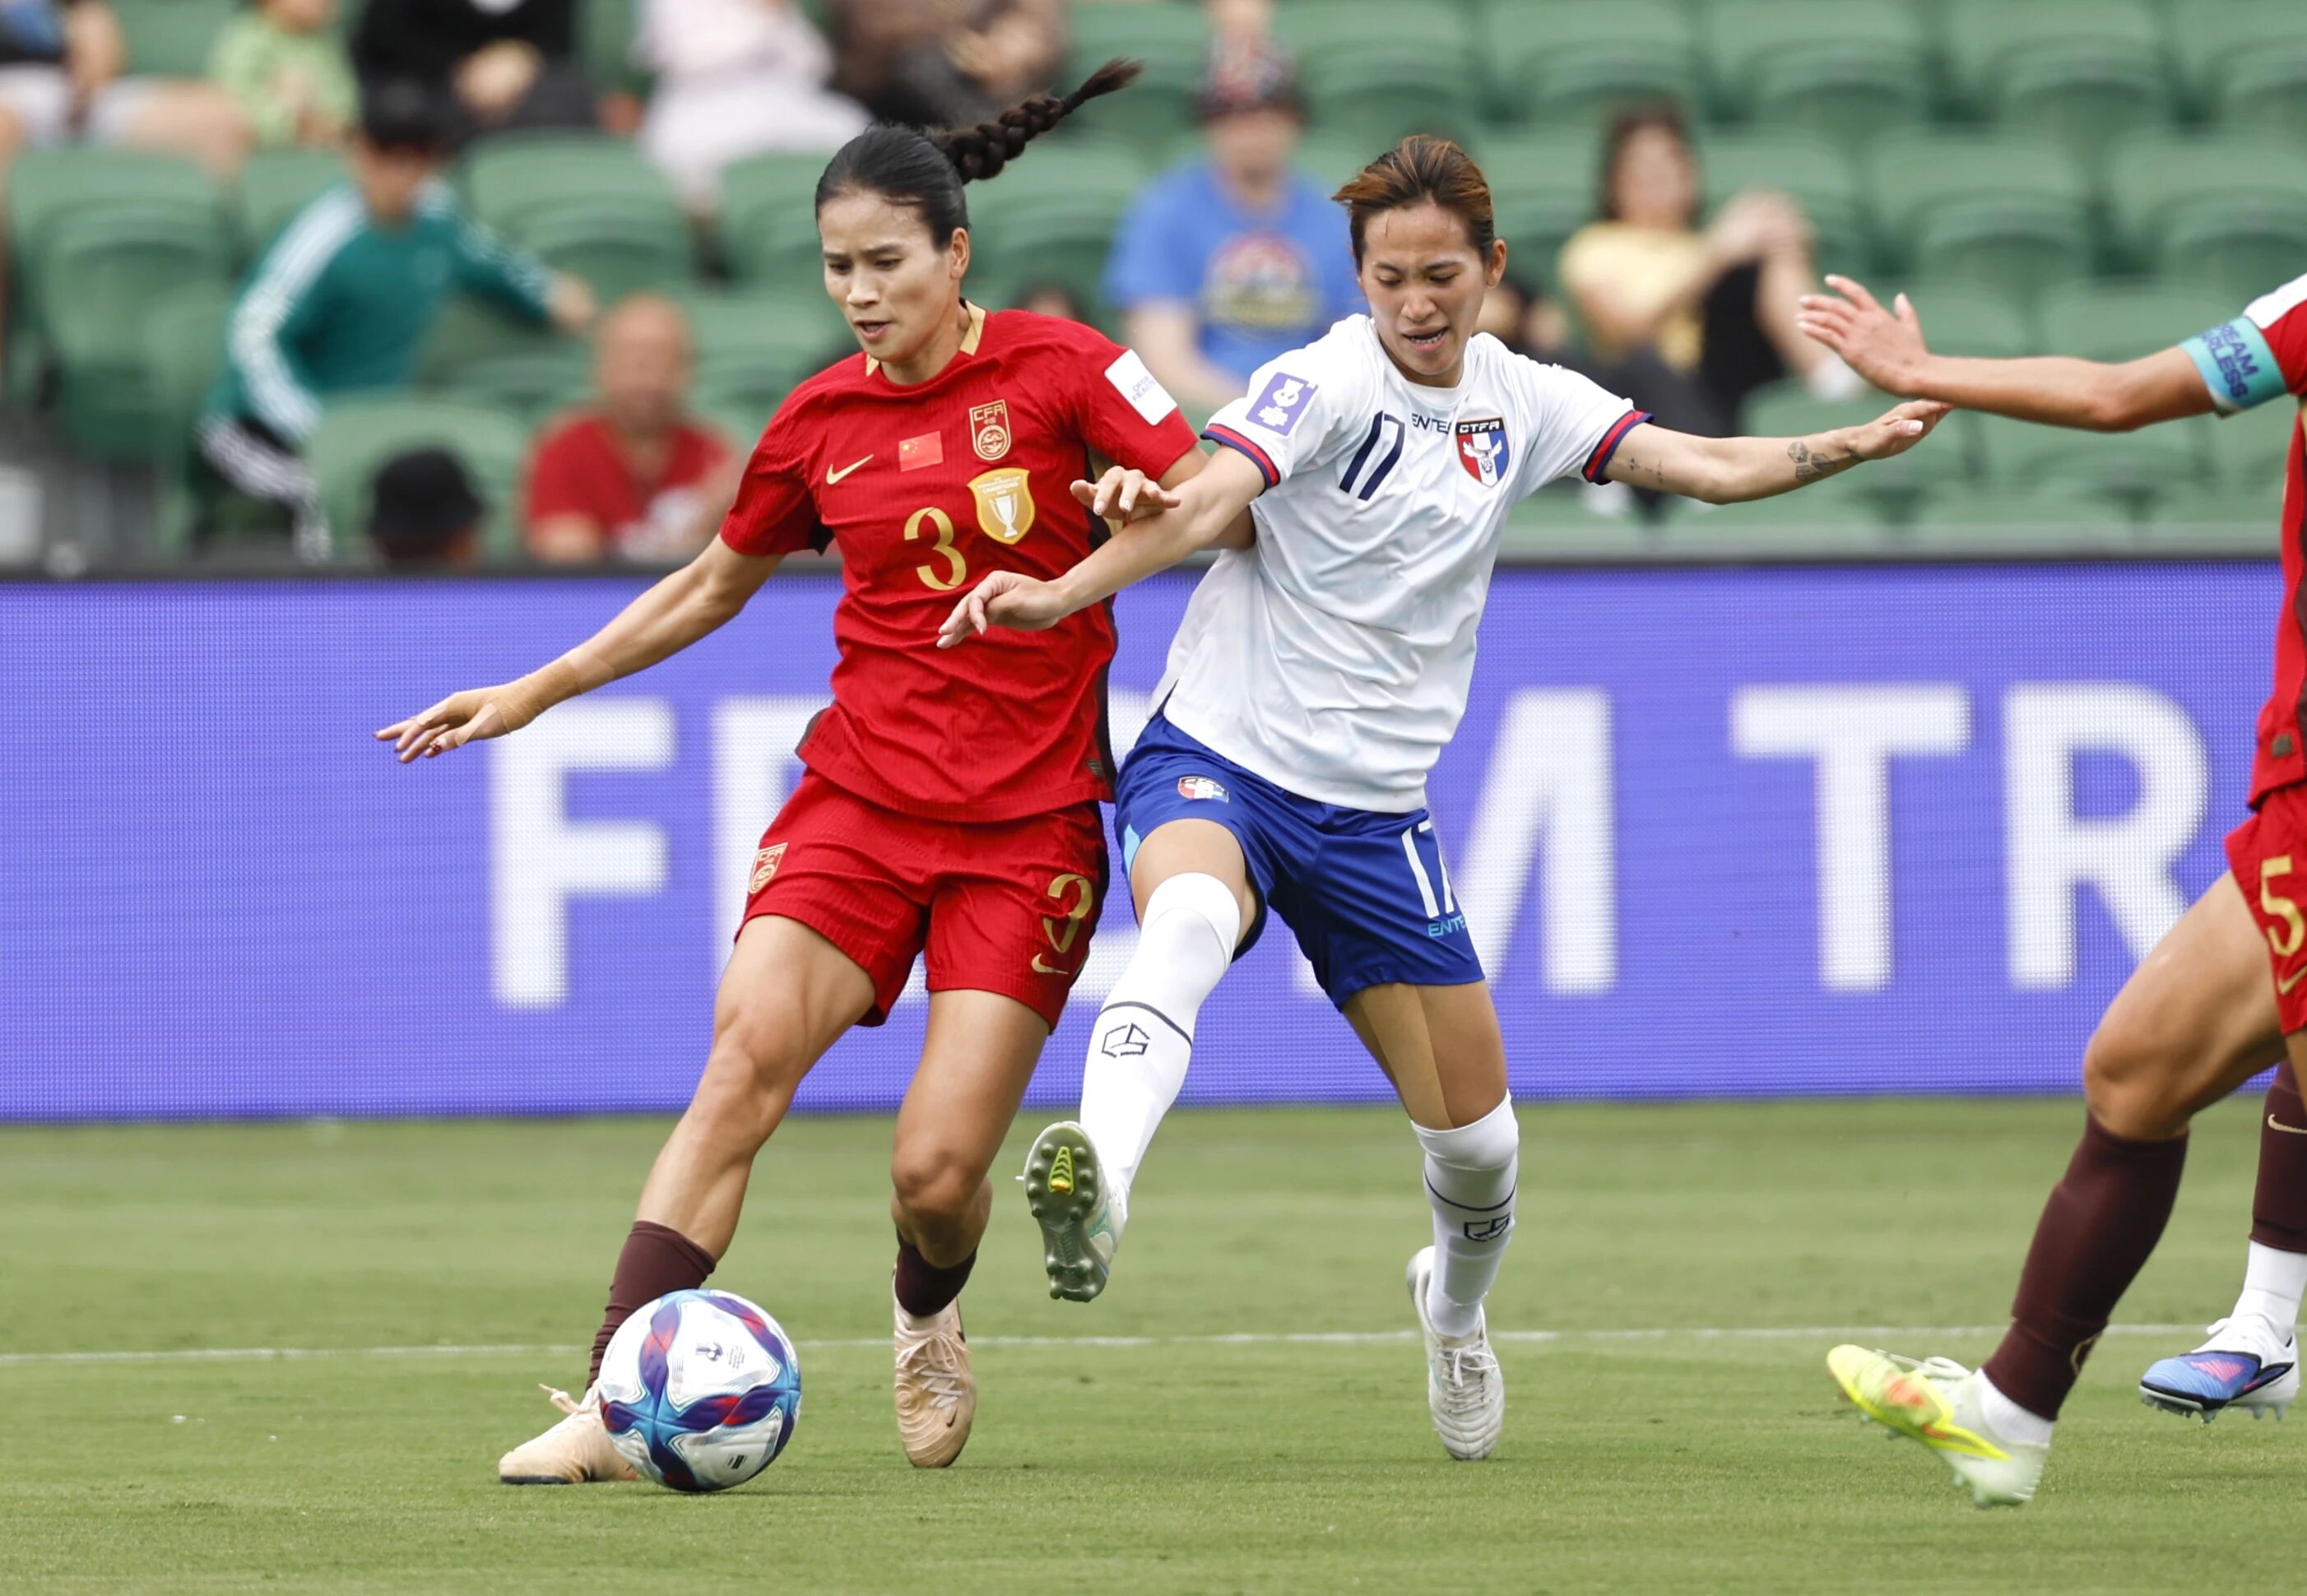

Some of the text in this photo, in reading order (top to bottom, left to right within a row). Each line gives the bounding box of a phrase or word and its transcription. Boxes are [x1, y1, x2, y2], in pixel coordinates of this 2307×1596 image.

[973, 404, 1005, 422] CFA
[1459, 420, 1500, 434] CTFA
[1339, 410, 1405, 502] 17
[903, 507, 967, 592] 3
[1042, 873, 1093, 954] 3
[2261, 853, 2305, 957] 5
